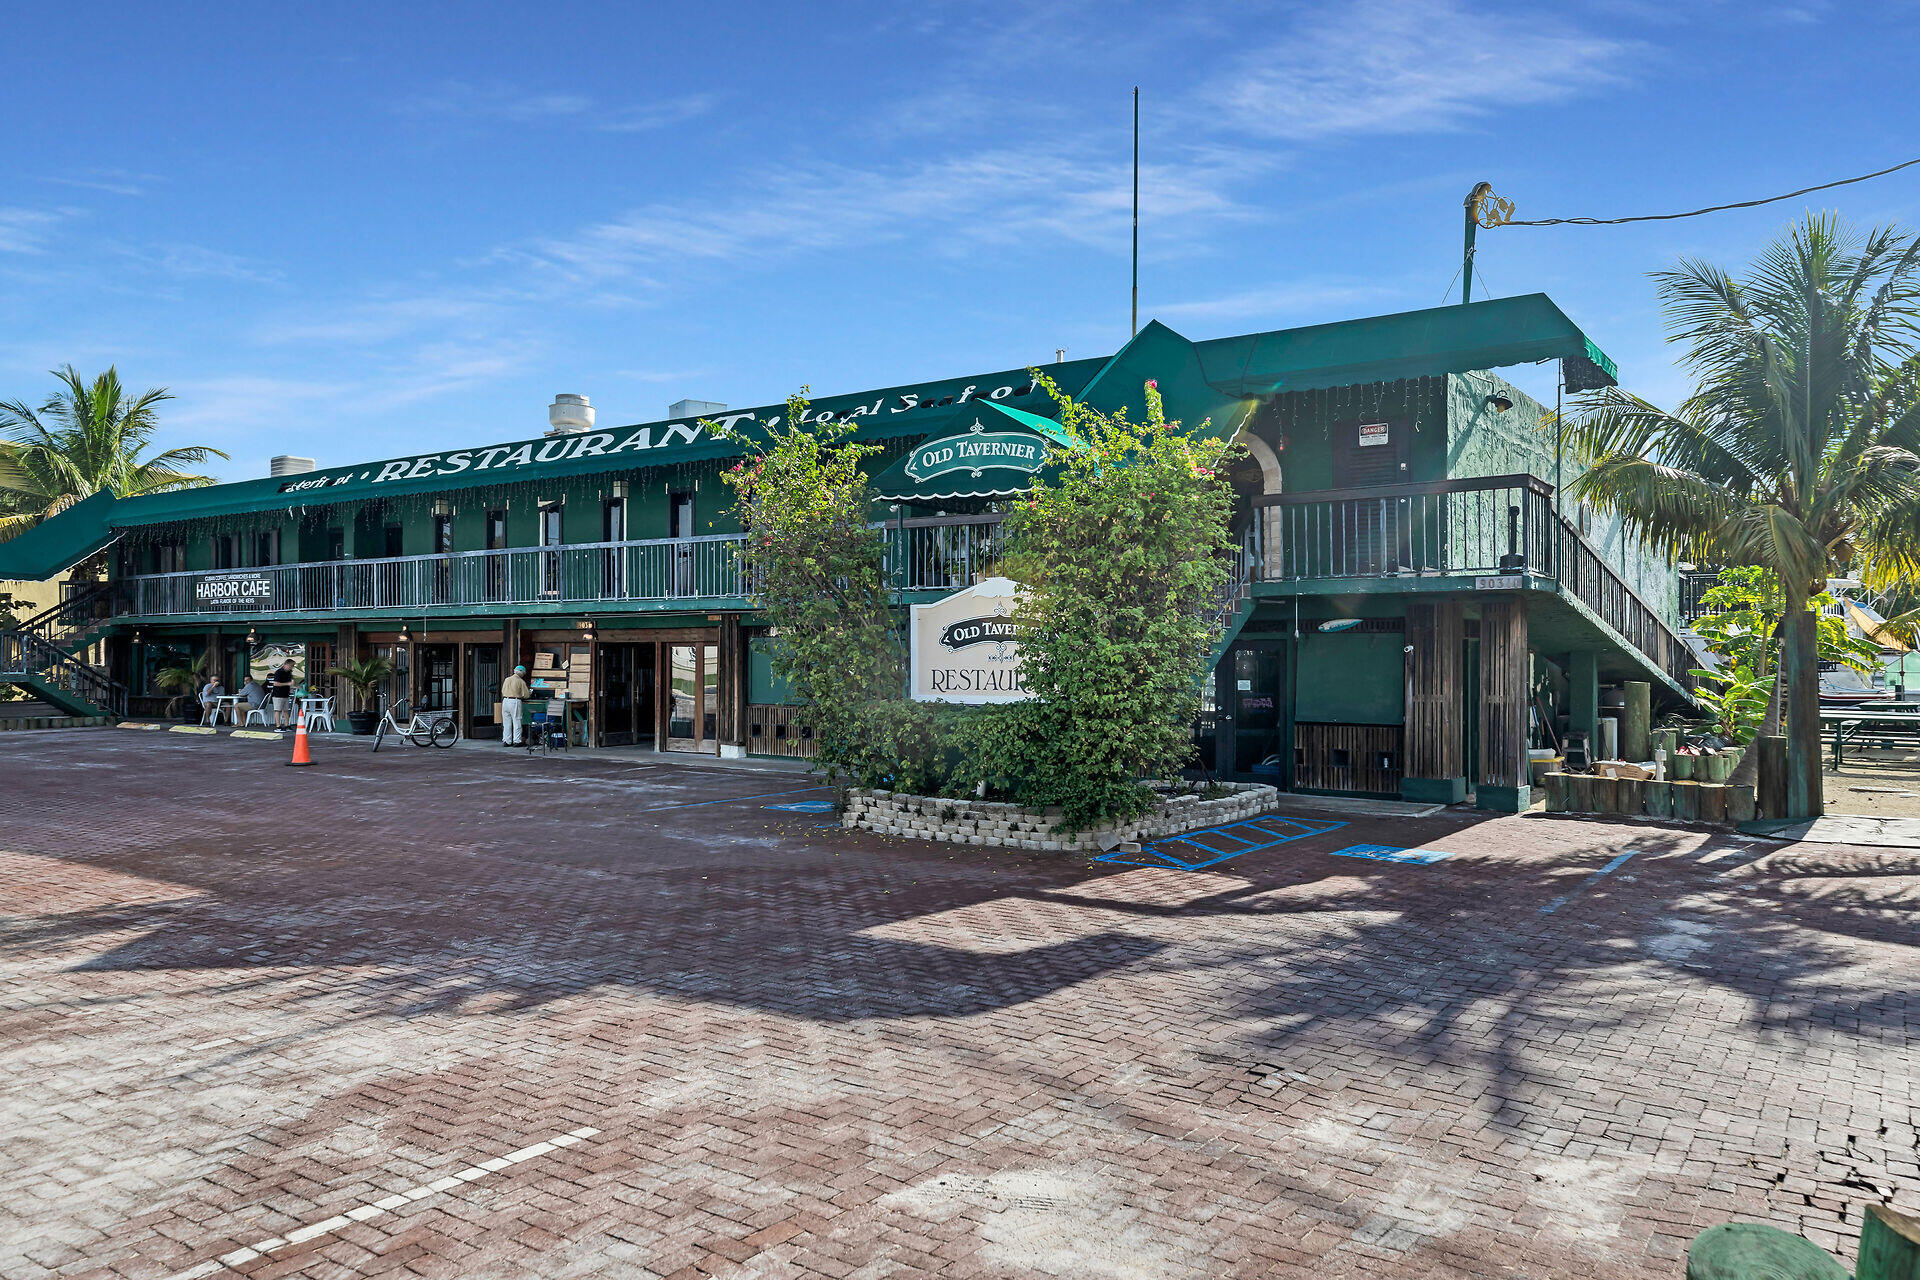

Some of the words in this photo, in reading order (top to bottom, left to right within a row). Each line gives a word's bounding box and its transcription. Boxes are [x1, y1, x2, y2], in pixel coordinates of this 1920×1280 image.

[371, 413, 755, 483] RESTAURANT
[922, 447, 953, 467] OLD
[956, 440, 1036, 460] TAVERNIER
[196, 581, 239, 598] HARBOR
[241, 580, 270, 596] CAFE
[953, 626, 980, 641] OLD
[931, 668, 1031, 695] RESTAUR
